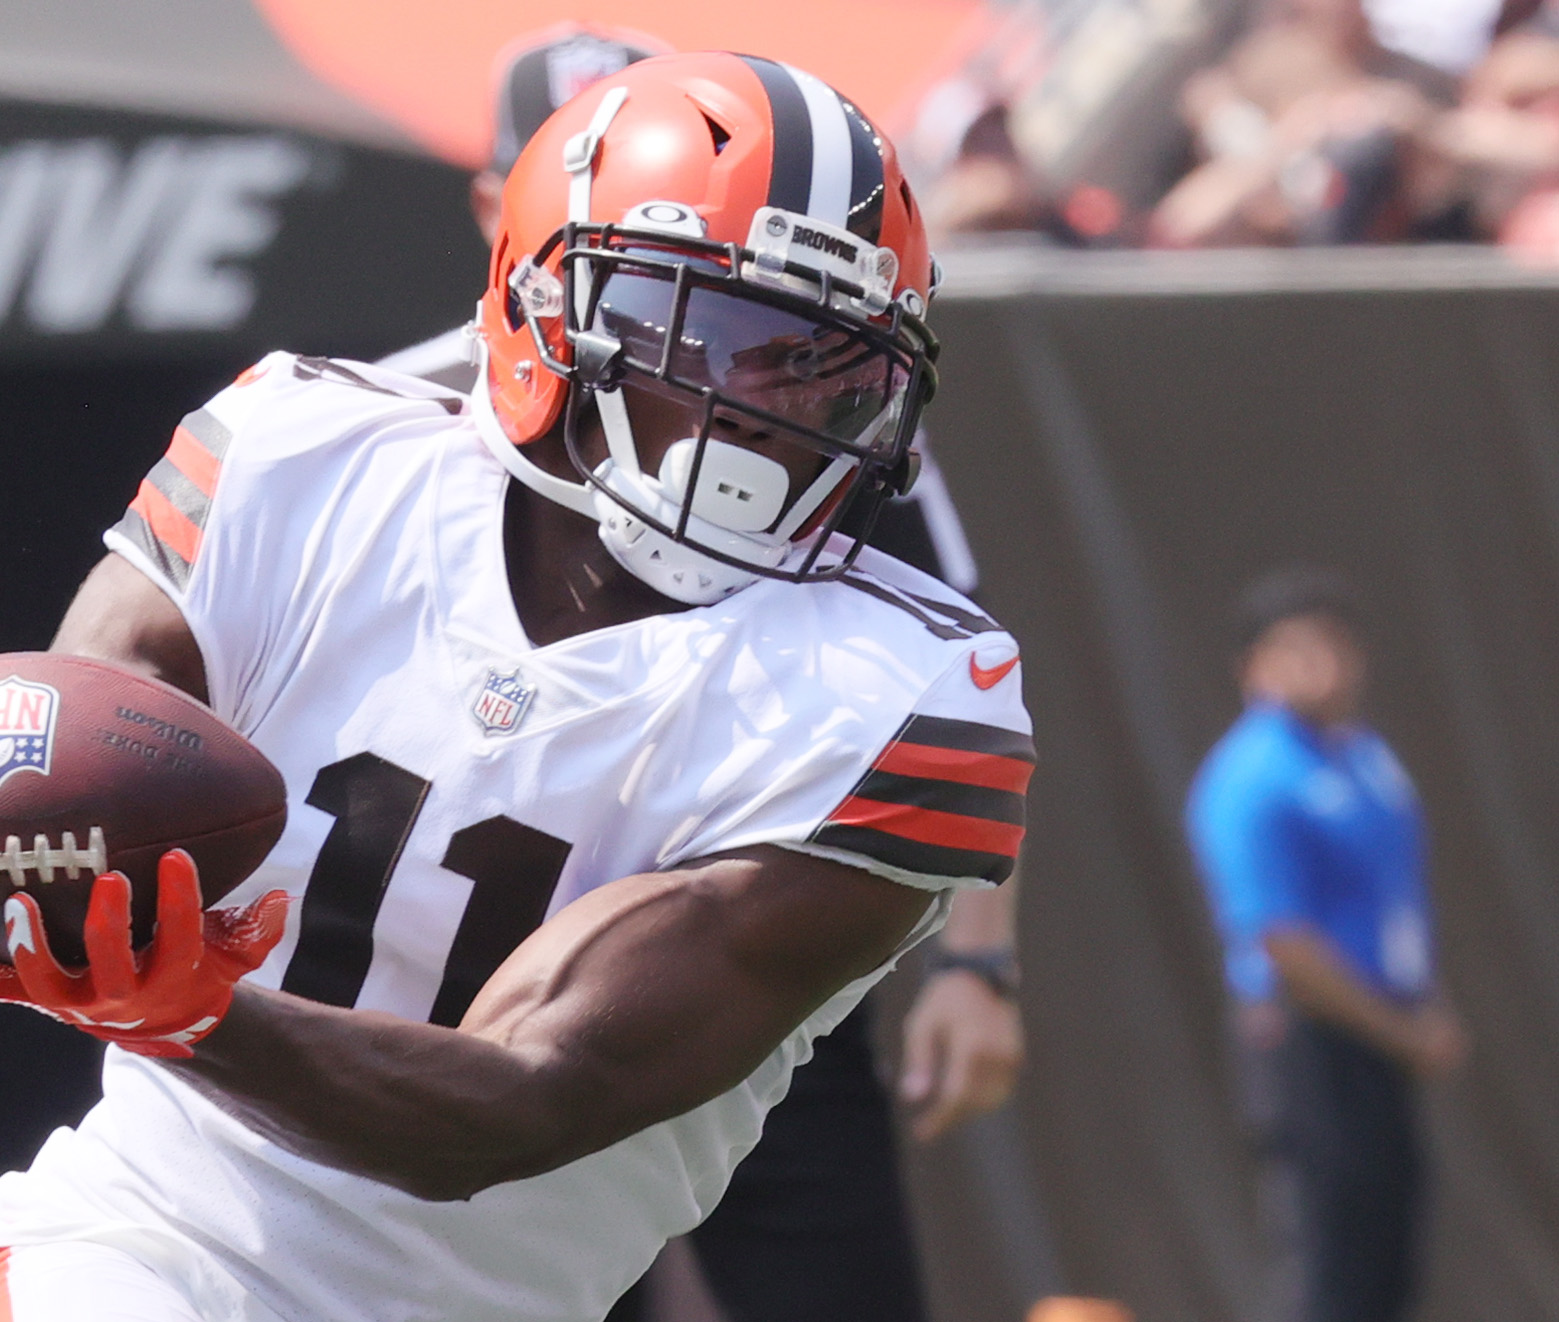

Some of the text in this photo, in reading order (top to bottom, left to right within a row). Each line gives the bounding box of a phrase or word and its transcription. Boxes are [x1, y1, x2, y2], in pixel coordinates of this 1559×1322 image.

[791, 224, 859, 264] BROWNS
[478, 693, 514, 726] NFL
[280, 751, 575, 1030] 11
